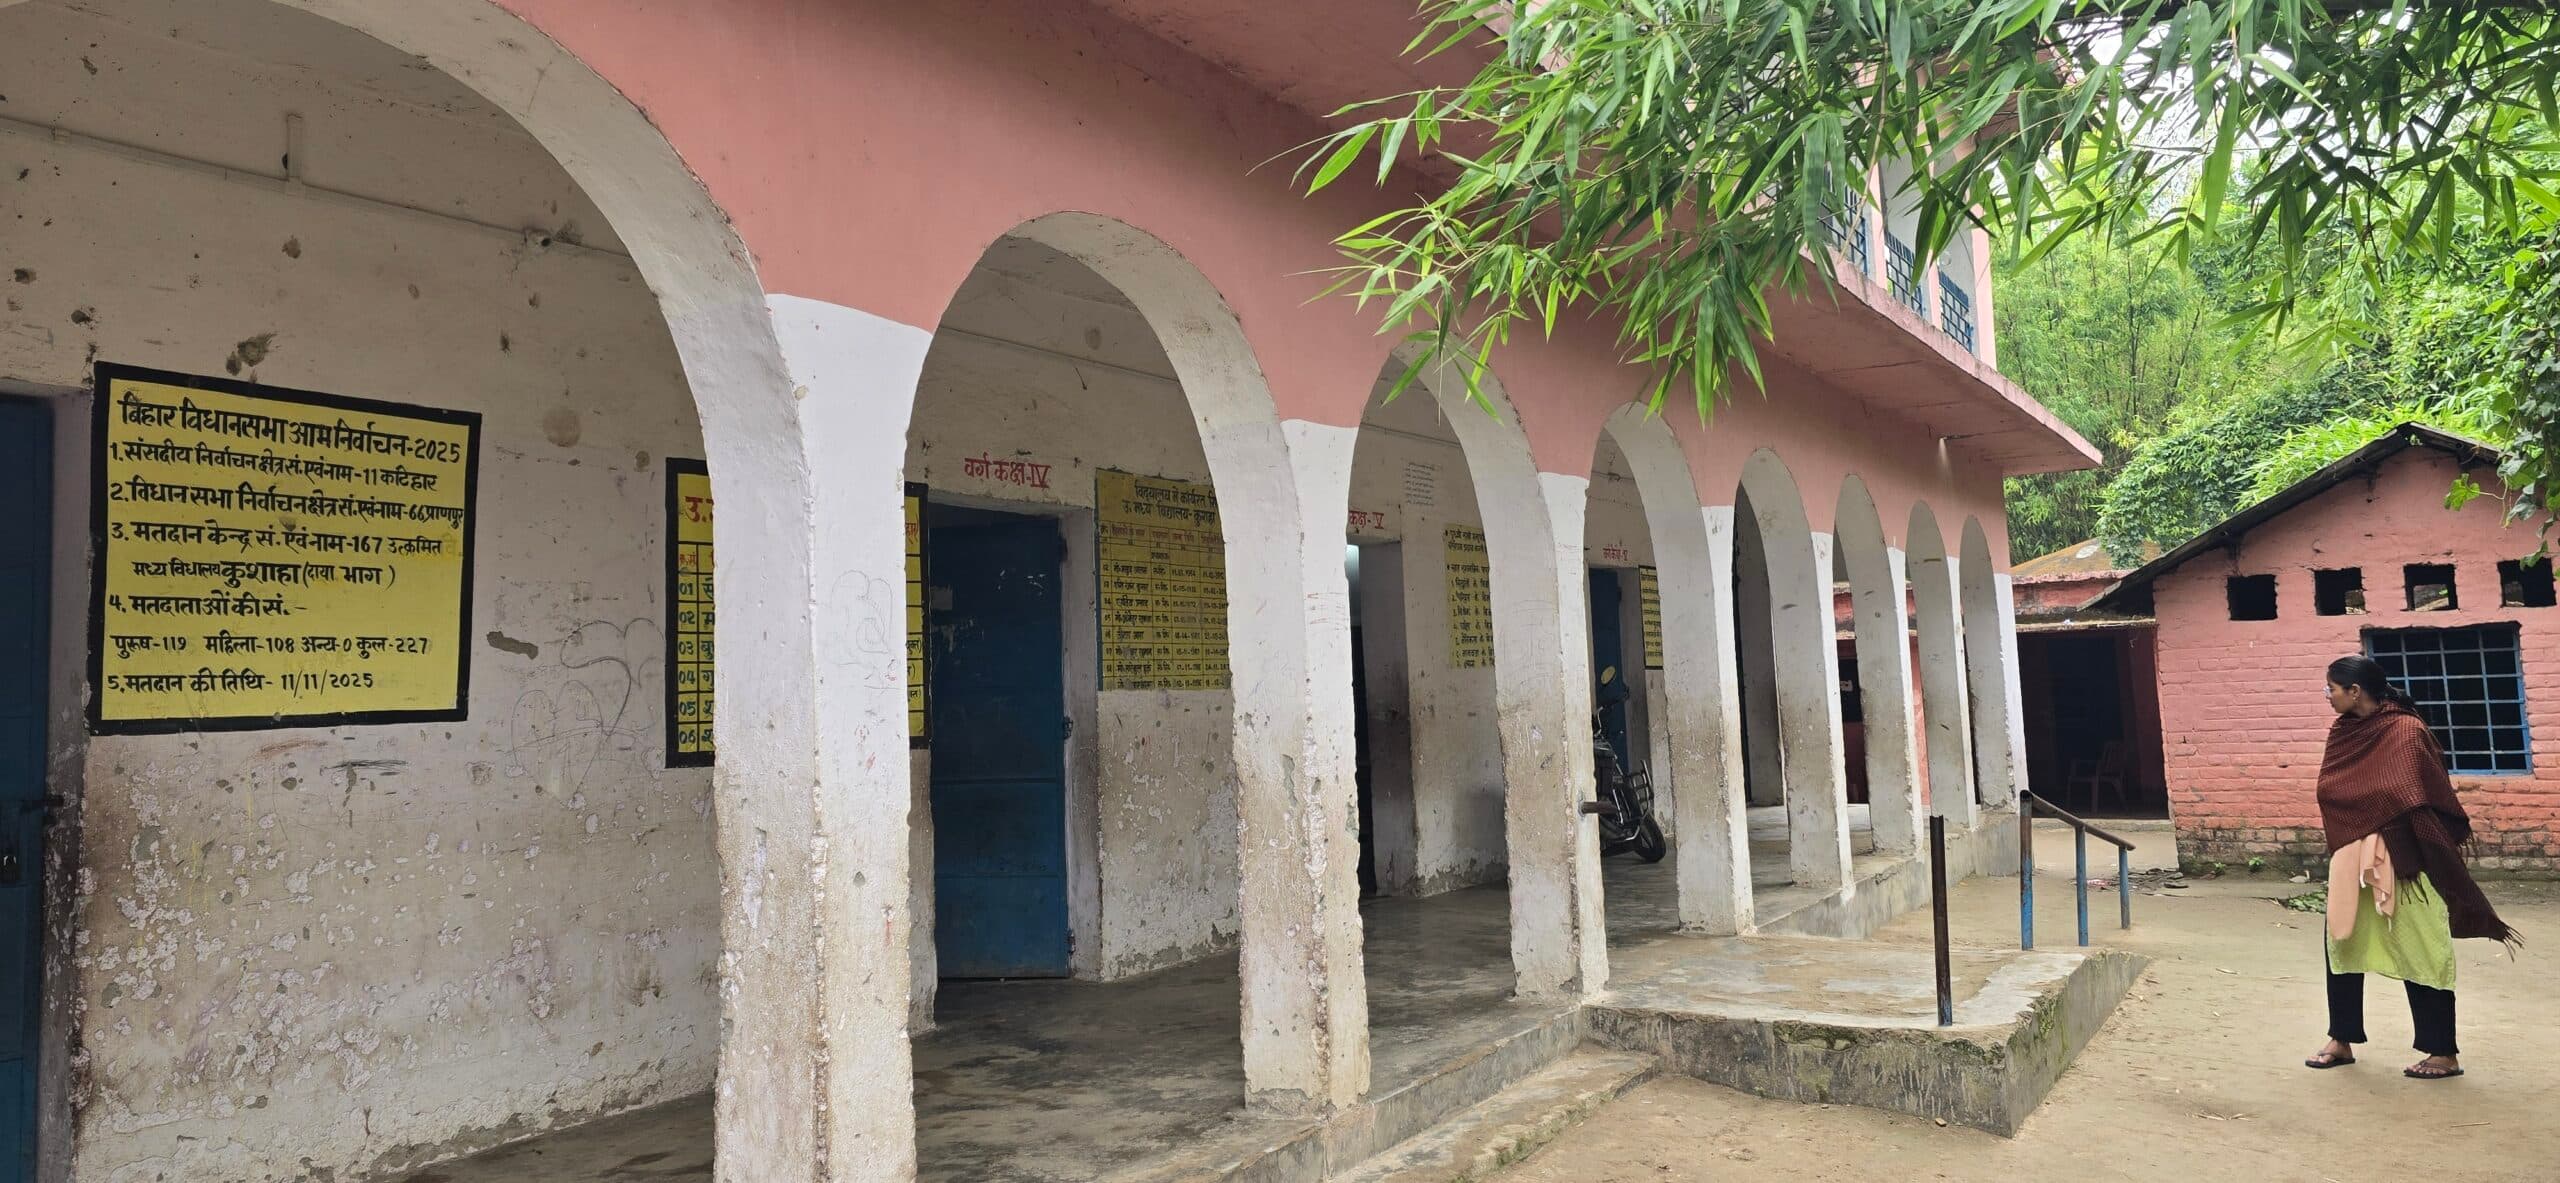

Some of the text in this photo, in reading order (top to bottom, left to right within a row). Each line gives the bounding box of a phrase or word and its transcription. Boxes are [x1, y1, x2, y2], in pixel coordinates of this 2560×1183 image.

[117, 391, 178, 428] बिहार
[179, 397, 289, 444] विधानसभा
[289, 421, 331, 448] आम
[123, 437, 193, 466] संसदीय
[194, 442, 258, 471] निर्वाचन
[379, 465, 437, 491] कटिहार
[964, 451, 992, 479] वर्ग
[235, 481, 308, 515] निर्वाचन
[422, 504, 464, 530] प्राणपुर
[111, 522, 129, 541] 3.
[130, 521, 205, 546] मतदान
[204, 519, 253, 554] केन्द्र
[132, 561, 167, 578] मध्य
[219, 560, 302, 588] कुशाहा
[109, 593, 127, 613] 4.
[128, 589, 231, 616] मतदाताओं
[231, 591, 261, 617] की
[679, 582, 694, 596] 01
[680, 610, 695, 625] 02
[679, 641, 695, 656] 03
[108, 675, 125, 694] 5.
[123, 674, 186, 694] मतदान
[189, 667, 219, 693] की
[281, 668, 374, 698] 11/11/2025
[679, 670, 696, 685] 04
[679, 702, 696, 717] 05
[680, 729, 697, 745] 06
